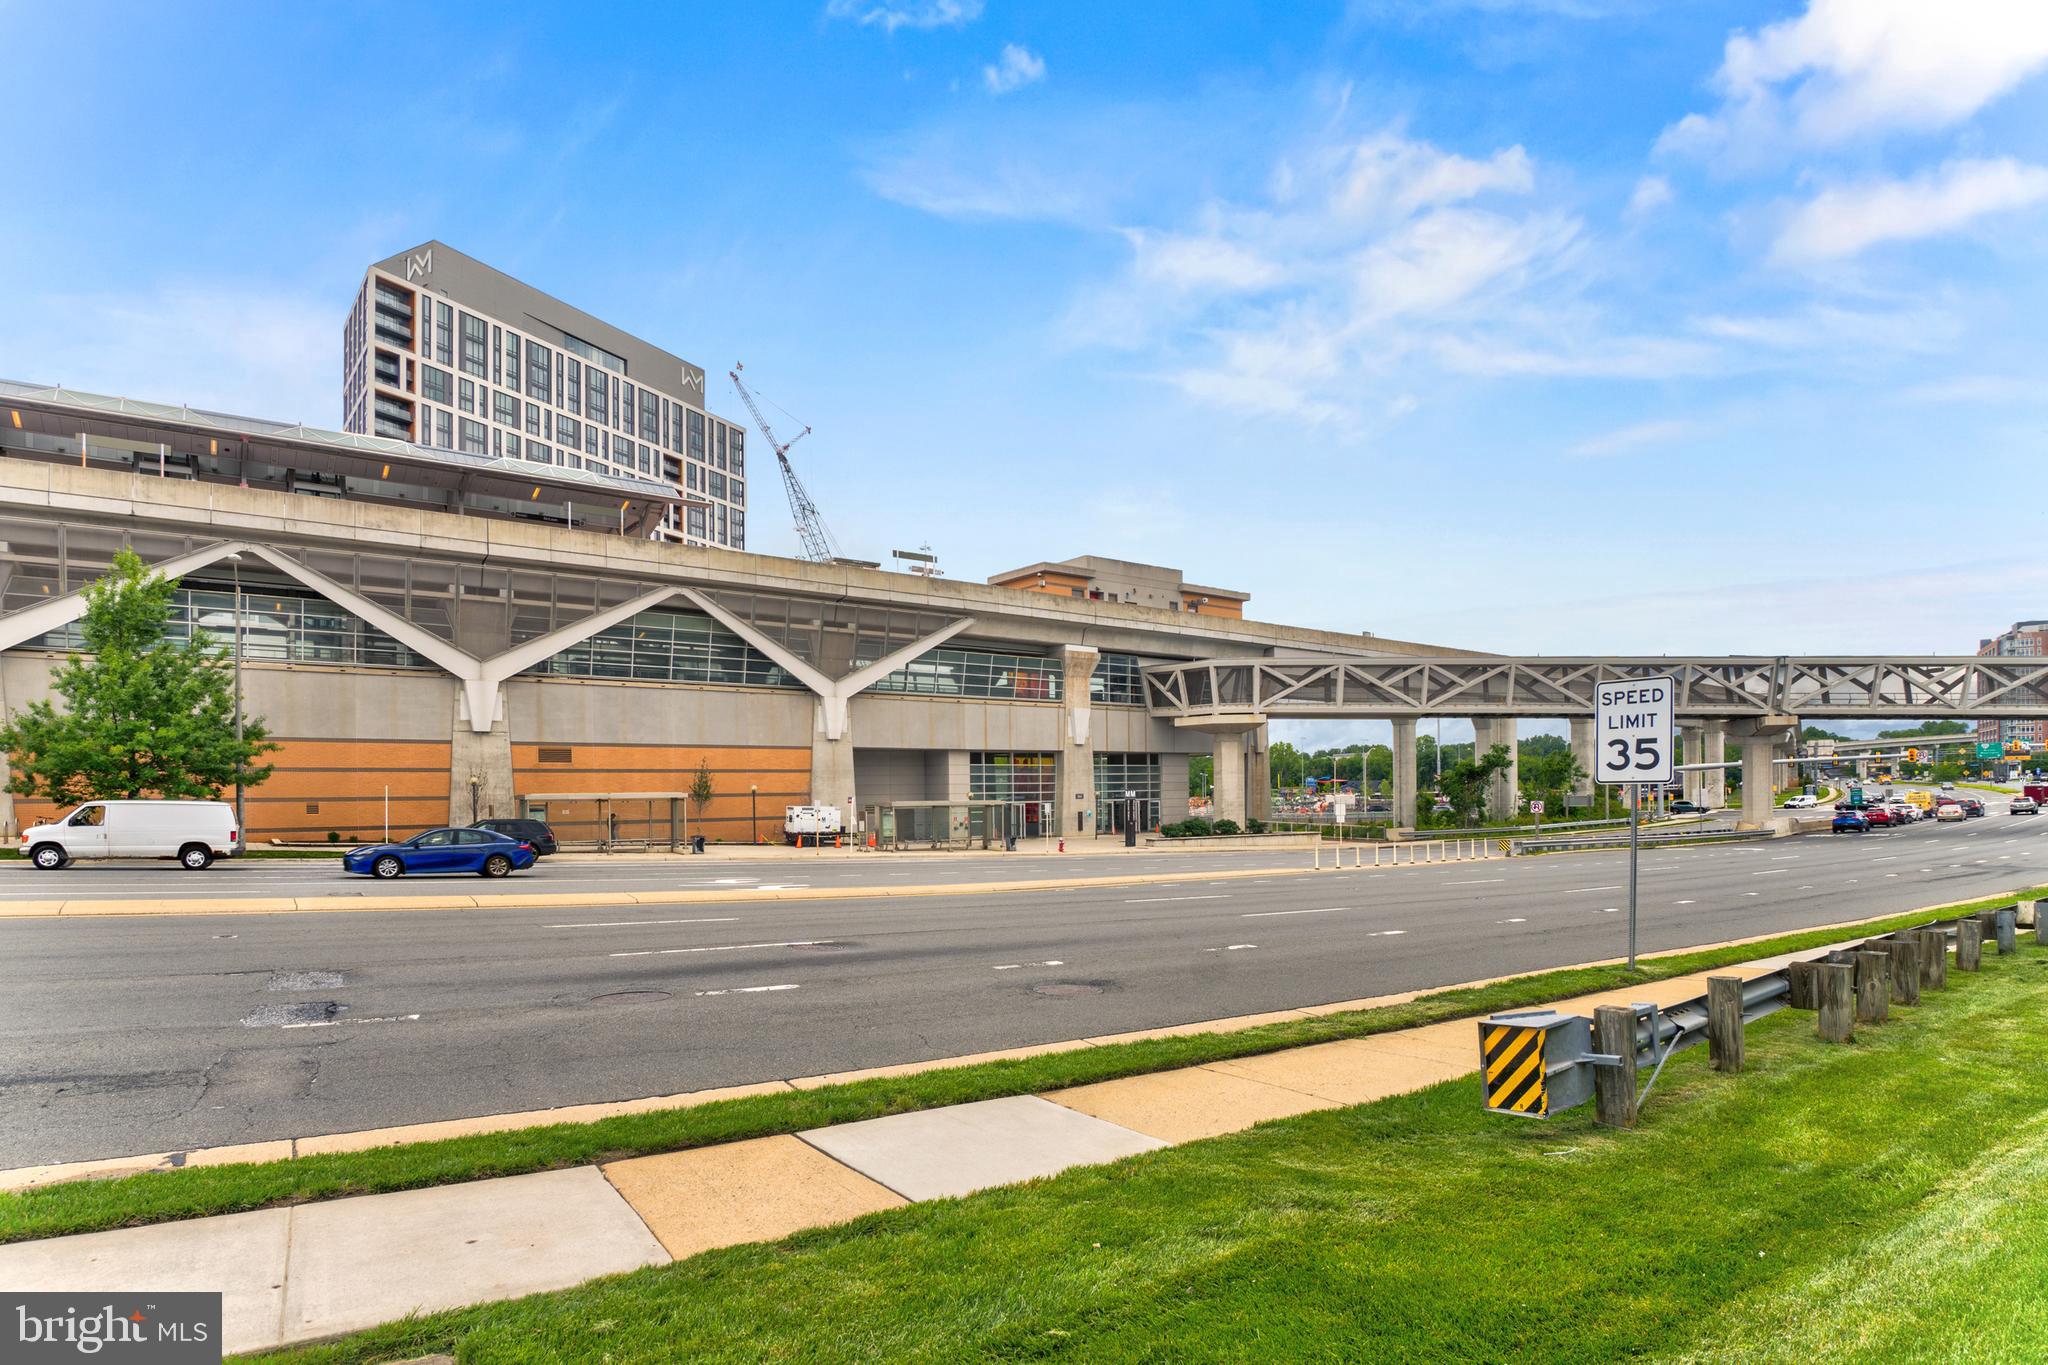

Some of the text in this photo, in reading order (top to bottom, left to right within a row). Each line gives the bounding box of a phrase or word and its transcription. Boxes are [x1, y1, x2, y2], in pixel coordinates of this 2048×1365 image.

[1601, 688, 1664, 706] SPEED
[1608, 713, 1658, 730] LIMIT
[1606, 737, 1660, 771] 35
